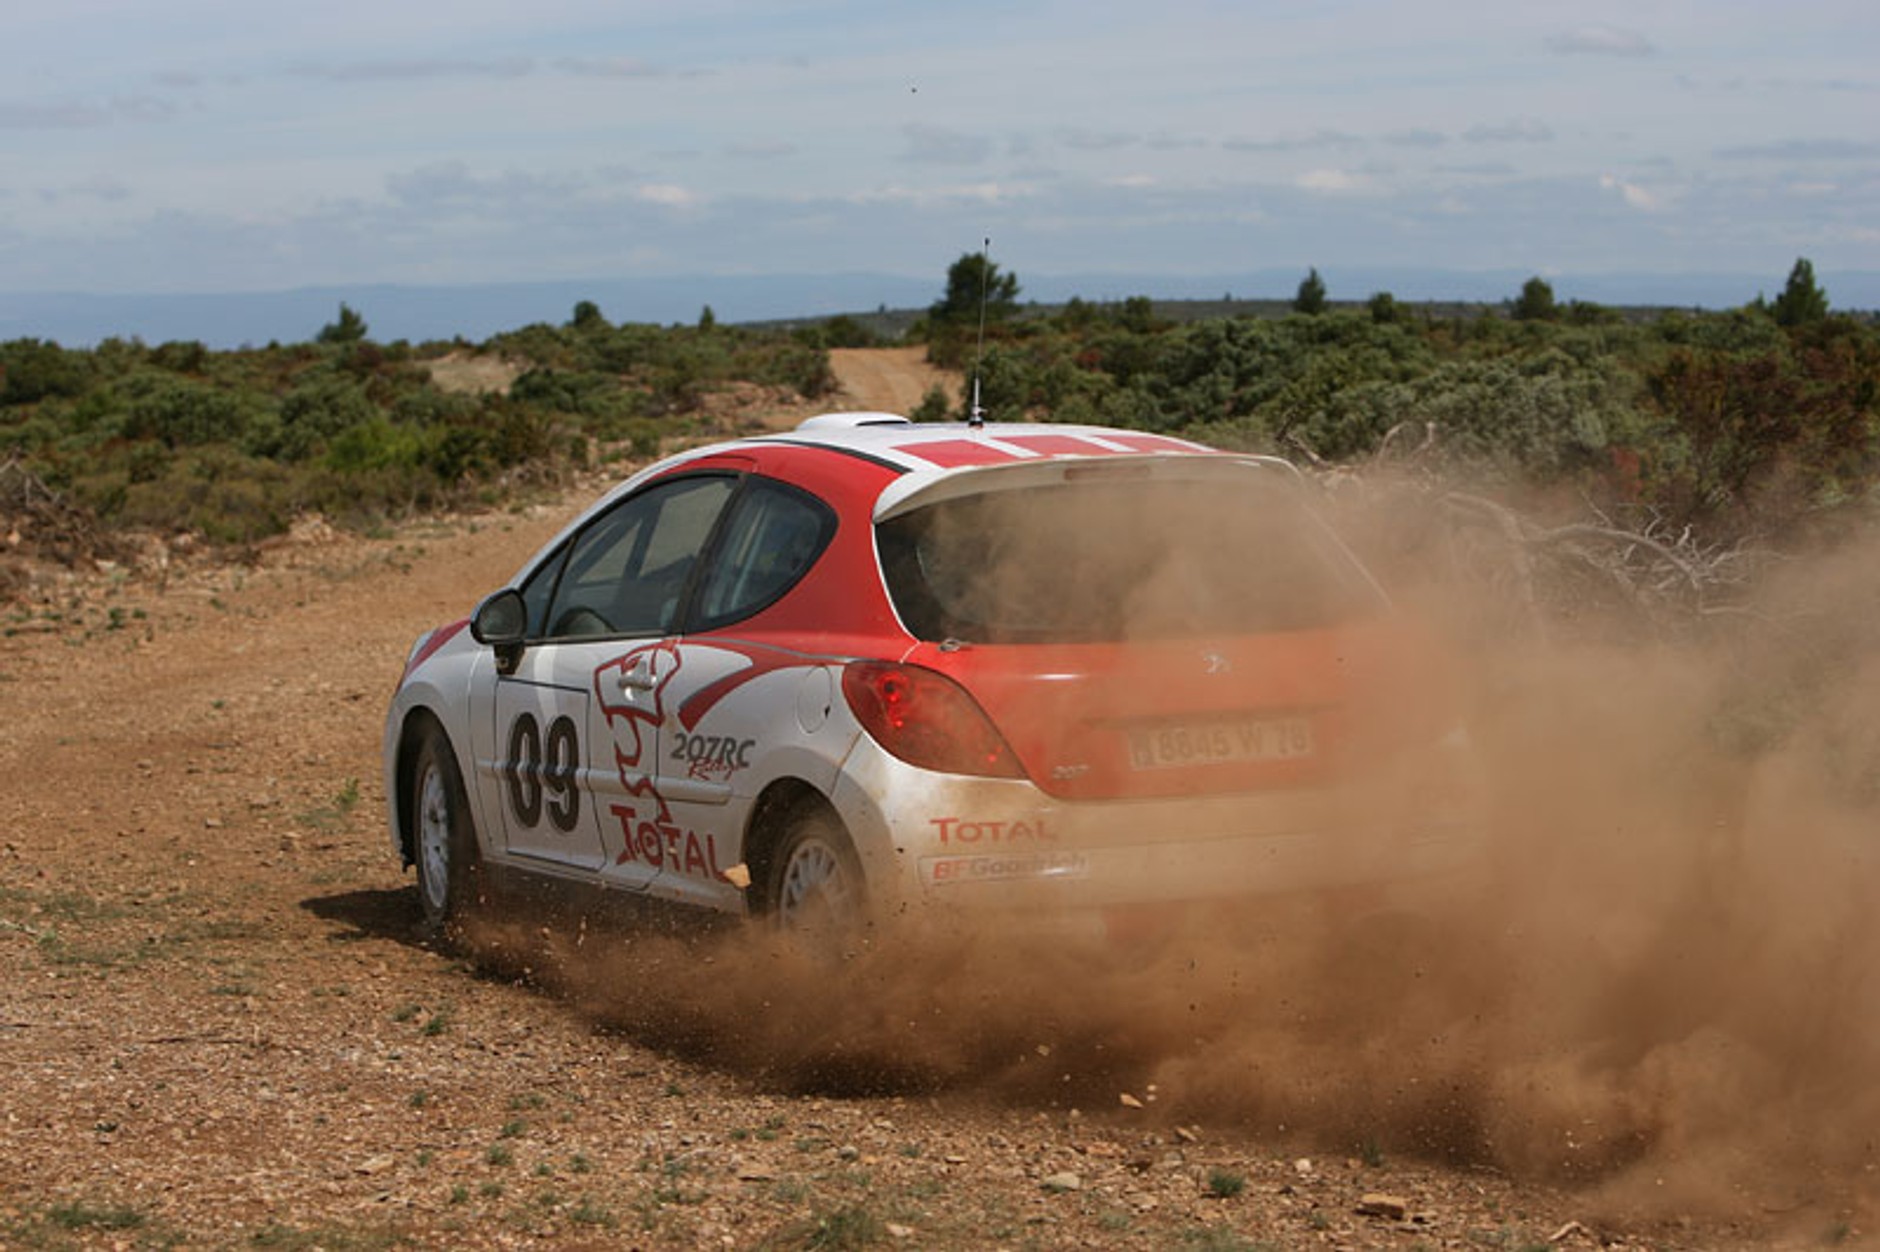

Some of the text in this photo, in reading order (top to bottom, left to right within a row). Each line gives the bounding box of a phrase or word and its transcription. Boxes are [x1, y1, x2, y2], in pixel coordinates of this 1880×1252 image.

[508, 711, 580, 832] 09
[670, 732, 756, 768] 207RC
[610, 805, 738, 884] TOTAL
[929, 818, 1059, 845] TOTAL
